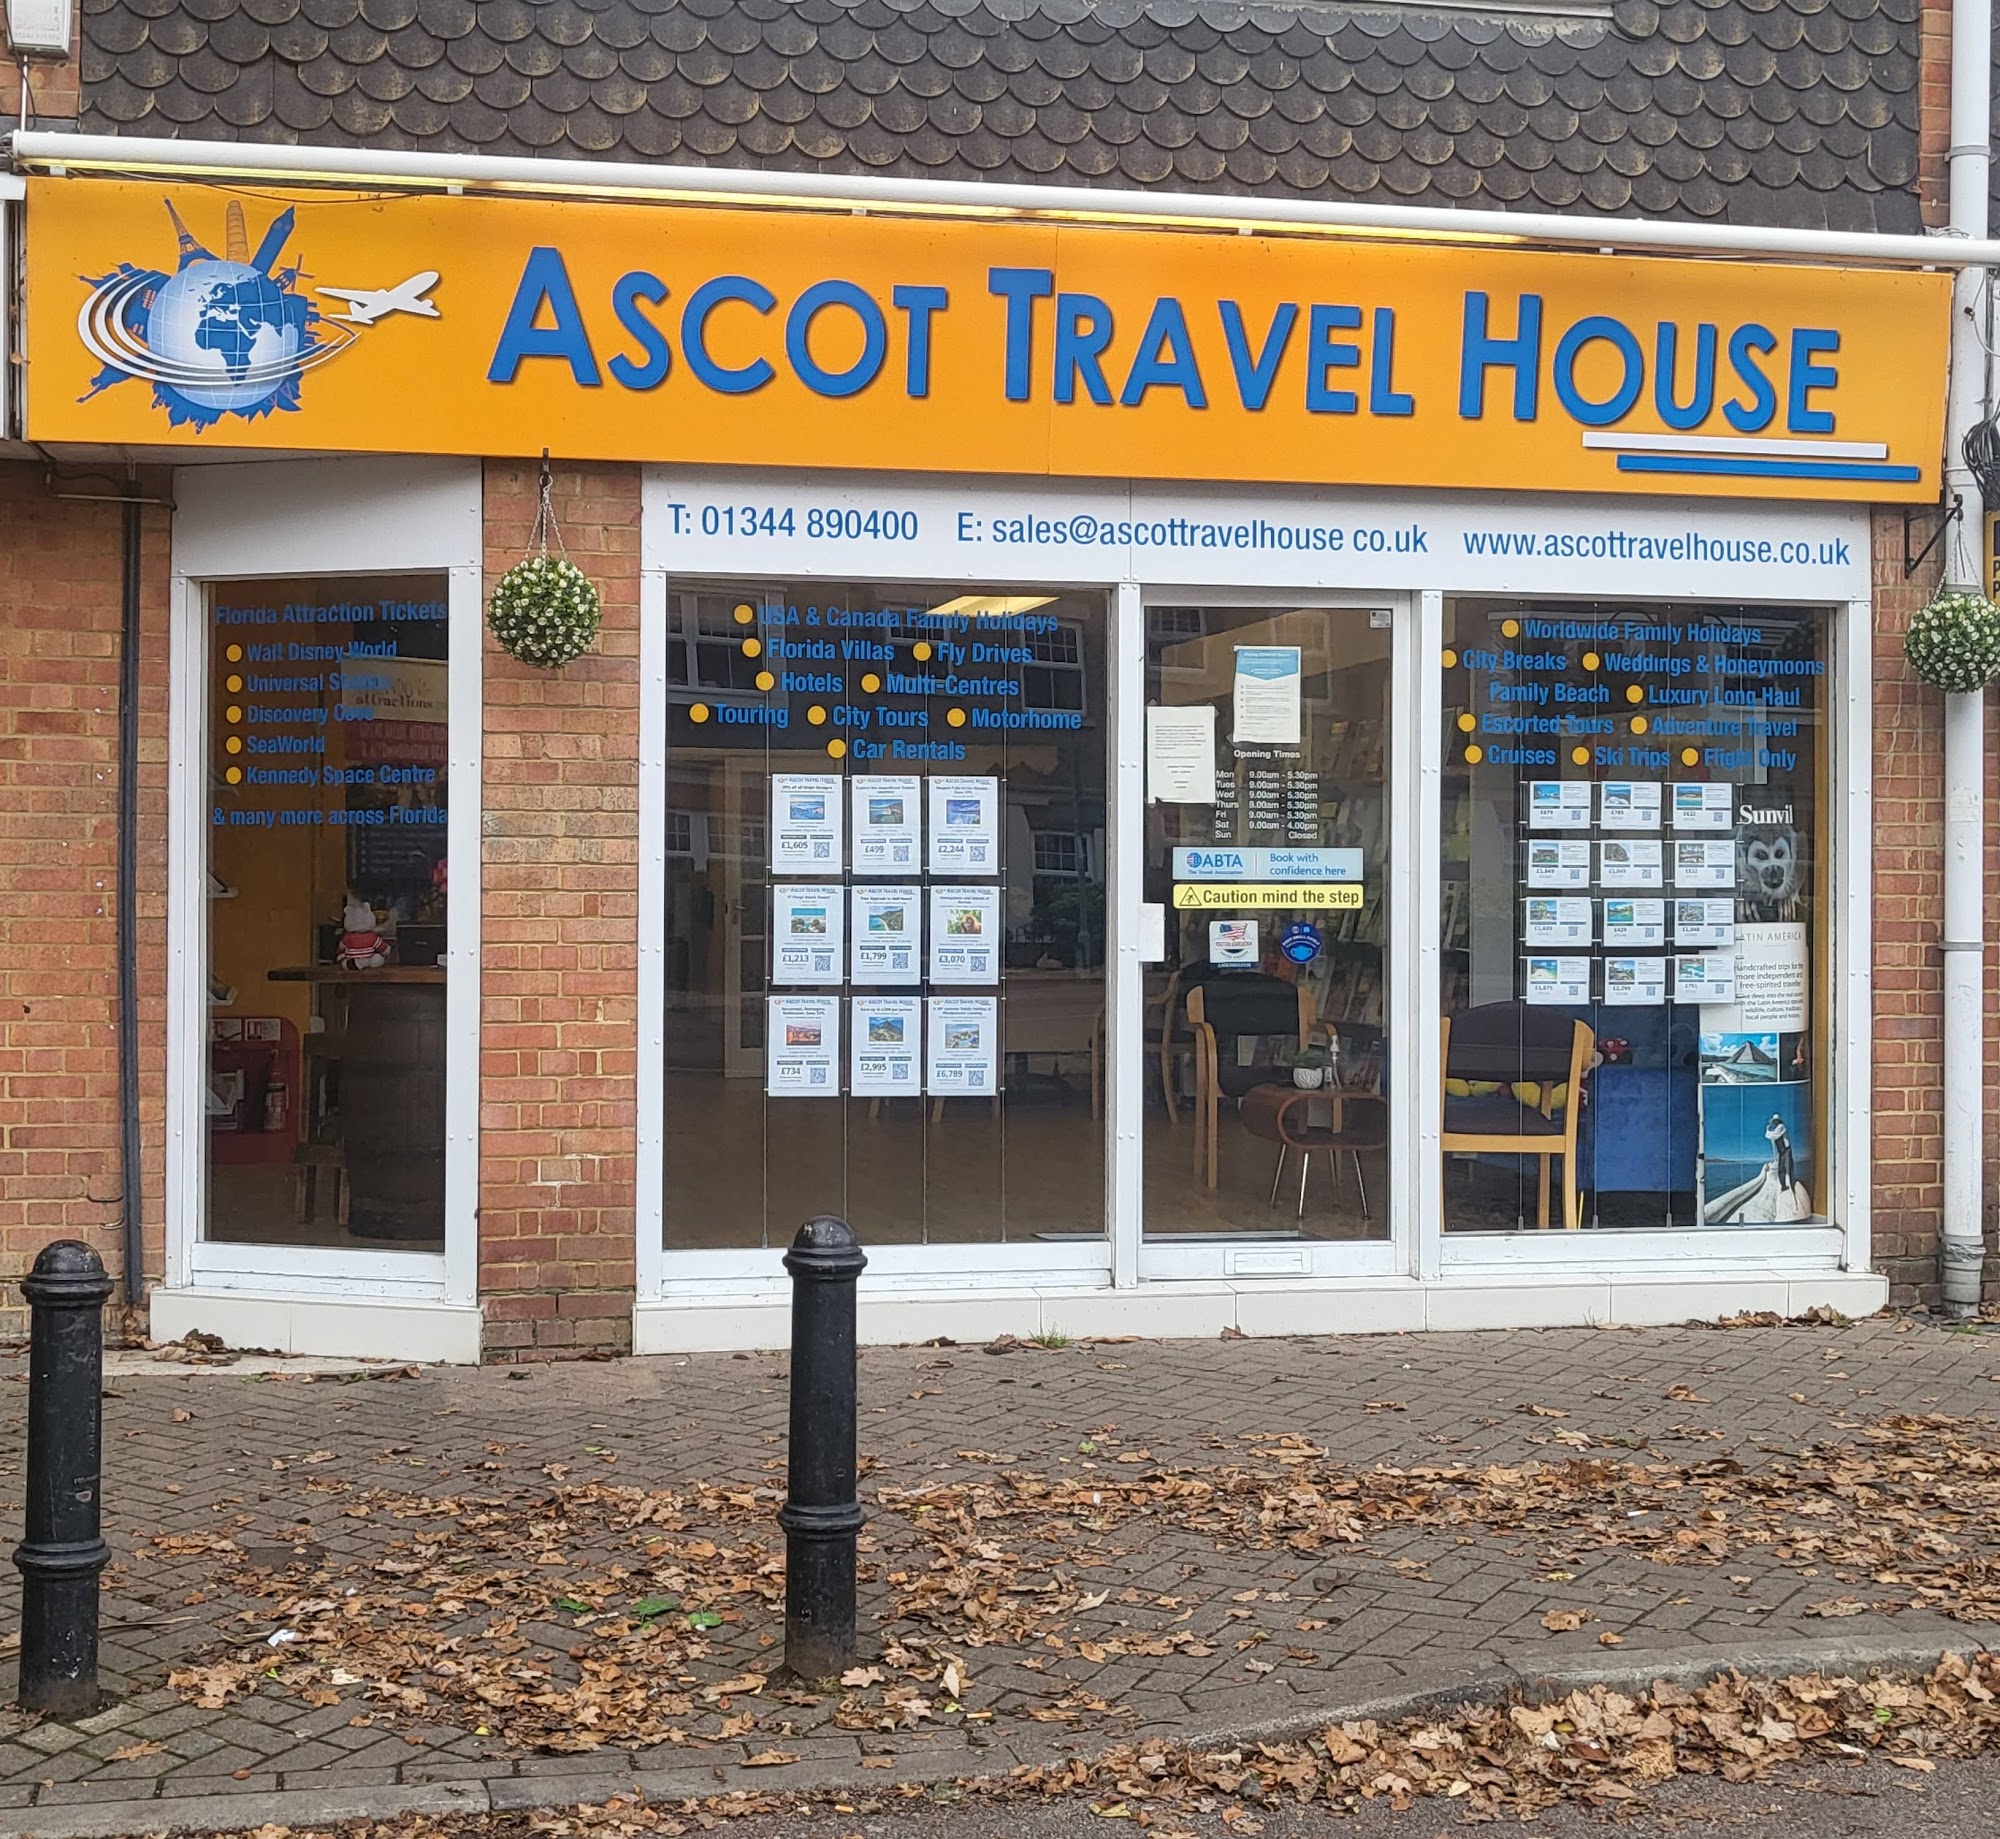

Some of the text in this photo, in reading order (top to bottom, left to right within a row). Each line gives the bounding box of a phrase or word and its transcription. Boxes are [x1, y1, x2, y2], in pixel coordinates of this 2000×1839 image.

[486, 246, 1840, 434] ASCOT TRAVEL HOUSE
[667, 504, 919, 541] T: 01344 890400
[958, 512, 983, 543] E:
[1464, 531, 1850, 566] www.ascottravelhouse.co.uk
[215, 601, 446, 624] Florida Attraction Tickets
[760, 607, 1059, 635] USA & Canada Family Holidays
[1525, 620, 1761, 645] Worldwide Family Holidays
[248, 640, 398, 663] Walt Disney World
[768, 638, 895, 661] Florida Villas
[938, 643, 1032, 666] Fly Drives
[1463, 650, 1567, 671] City Breaks
[1605, 653, 1824, 678] Weddings & Honeymoons
[248, 675, 324, 691] Universal
[782, 673, 843, 693] Hotels
[886, 674, 1019, 697] Multi-Centres
[356, 693, 433, 708] attractions
[1490, 683, 1609, 705] Family Beach
[1648, 687, 1800, 708] Luxury Long Haul
[248, 705, 328, 725] Discovery
[716, 704, 789, 729] Touring
[833, 706, 928, 729] City Tours
[972, 708, 1082, 729] Motorhome
[1482, 714, 1613, 734] Escorted Tours
[1652, 716, 1797, 736] Adventure Travel
[248, 736, 325, 754] SeaWorld
[853, 739, 965, 761] Car Rentals
[1234, 750, 1301, 760] Opening Times
[1488, 746, 1556, 766] Cruises
[1595, 747, 1670, 768] Ski Trips
[1759, 748, 1796, 770] Only
[248, 765, 435, 787] Kennedy Space Centre
[1216, 770, 1234, 779] Mon
[1287, 771, 1318, 781] 5.30pm
[1216, 780, 1236, 789] Tues
[1287, 781, 1318, 791] 5.30pm
[1216, 790, 1235, 799] Wed
[1287, 791, 1318, 801] 5.30pm
[1216, 800, 1239, 809] Thurs
[1287, 801, 1318, 811] 5.30pm
[213, 805, 447, 828] & many more across Florida
[1216, 810, 1227, 820] Fri
[1287, 812, 1318, 821] 5.30pm
[1739, 804, 1794, 825] Sunvil
[1216, 821, 1230, 830] Sat
[1287, 822, 1318, 831] 4.00pm
[1216, 831, 1318, 840] Sun Closed
[782, 841, 808, 850] £1,605
[864, 845, 884, 854] £499
[938, 846, 964, 854] £2,244
[1202, 854, 1243, 868] ABTA
[1270, 853, 1318, 863] Book with
[1270, 865, 1346, 876] confidence here
[1203, 890, 1359, 906] Caution mind the step
[1767, 932, 1802, 941] AMERICA
[782, 954, 809, 963] £1,213
[860, 952, 888, 961] £1,799
[938, 954, 966, 964] £3,070
[1734, 963, 1777, 972] Handcrafted
[1757, 972, 1795, 980] independent
[1740, 982, 1782, 990] free-spirited
[781, 1066, 801, 1076] £734
[860, 1063, 888, 1072] £2,995
[936, 1070, 963, 1079] £6,789
